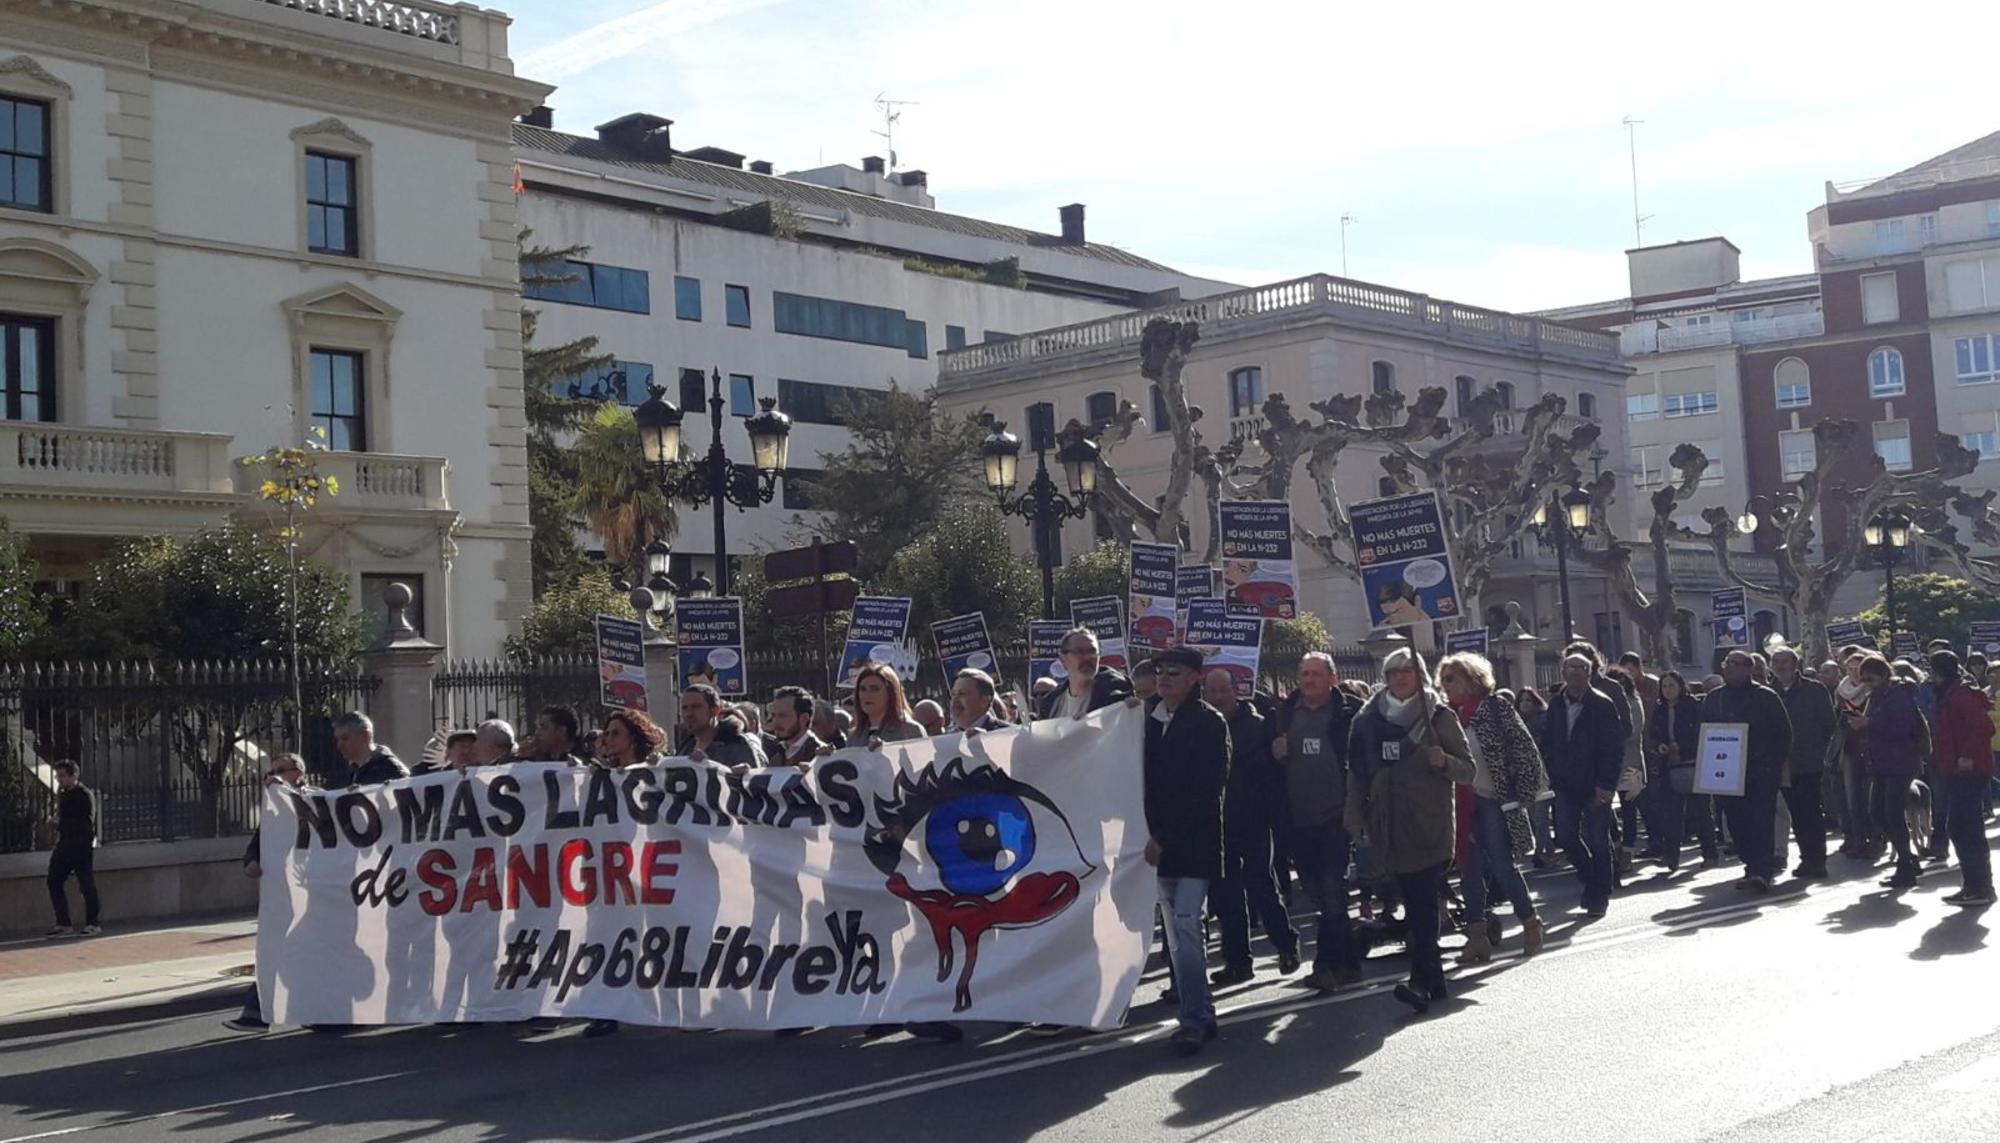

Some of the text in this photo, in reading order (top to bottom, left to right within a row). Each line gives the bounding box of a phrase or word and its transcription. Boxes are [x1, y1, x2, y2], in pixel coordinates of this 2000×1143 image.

[1227, 529, 1238, 538] NO
[1254, 530, 1288, 540] MUERTES
[1362, 534, 1376, 543] NO
[1396, 523, 1436, 538] MUERTES
[1236, 543, 1247, 552] EN
[1248, 543, 1257, 552] LA
[1376, 546, 1389, 556] EN
[1390, 544, 1401, 554] LA
[1193, 620, 1205, 629] NO
[1223, 621, 1257, 631] MUERTES
[1201, 631, 1212, 640] EN
[1213, 632, 1223, 640] LA
[288, 792, 383, 849] NO
[542, 760, 867, 830] LAGRIMAS
[350, 838, 682, 917] de SANGRE
[493, 910, 887, 1003] #Ap68LibreYa
